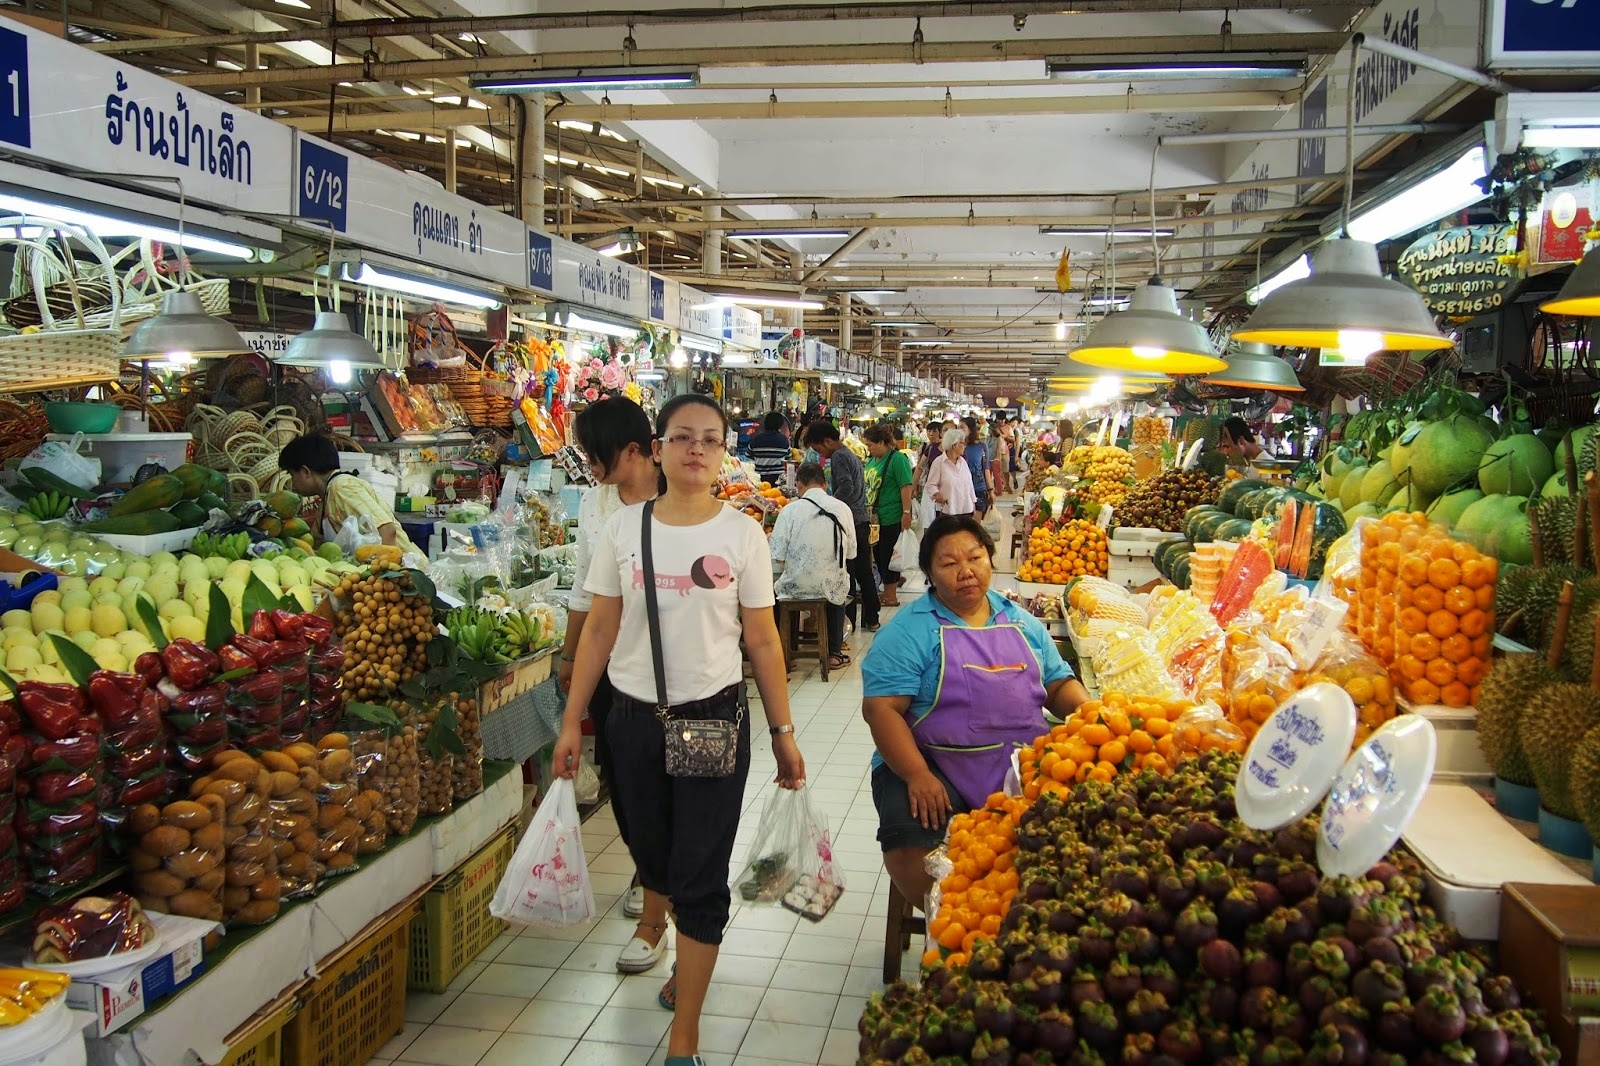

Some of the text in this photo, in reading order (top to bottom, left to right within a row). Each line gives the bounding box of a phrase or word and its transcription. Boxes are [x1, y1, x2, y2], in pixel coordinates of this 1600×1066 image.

[105, 71, 252, 186] ร้านป้าเล็ก
[304, 165, 343, 210] 6/12
[531, 247, 552, 276] 6/13
[1429, 280, 1494, 299] ตามฤดูกาล
[1424, 293, 1502, 314] 9-6814630
[655, 578, 676, 588] ogs
